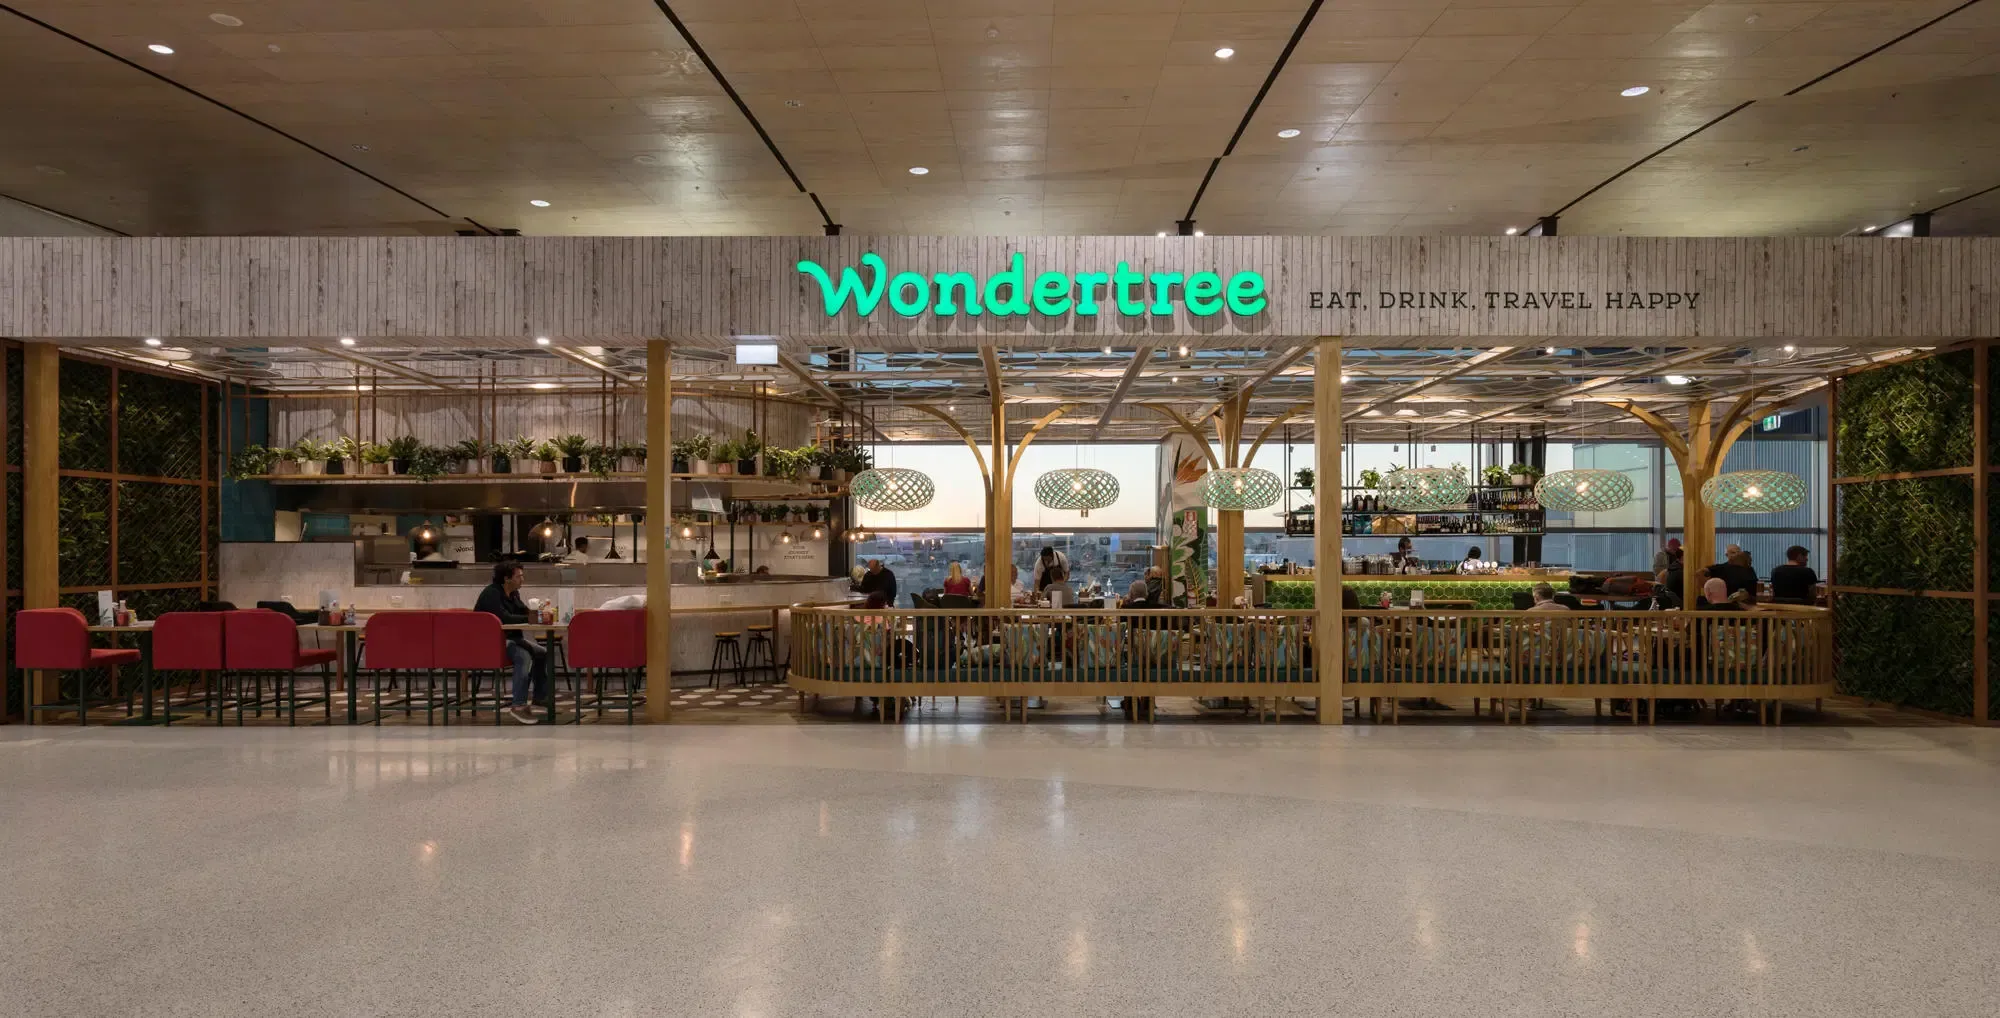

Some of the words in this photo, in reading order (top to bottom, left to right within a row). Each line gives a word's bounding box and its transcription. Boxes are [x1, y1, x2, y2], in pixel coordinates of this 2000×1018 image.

[796, 252, 1267, 317] Wondertree
[1309, 291, 1368, 311] EAT,
[1379, 291, 1476, 311] DRINK,
[1484, 291, 1592, 309] TRAVEL
[1605, 291, 1700, 309] HAPPY
